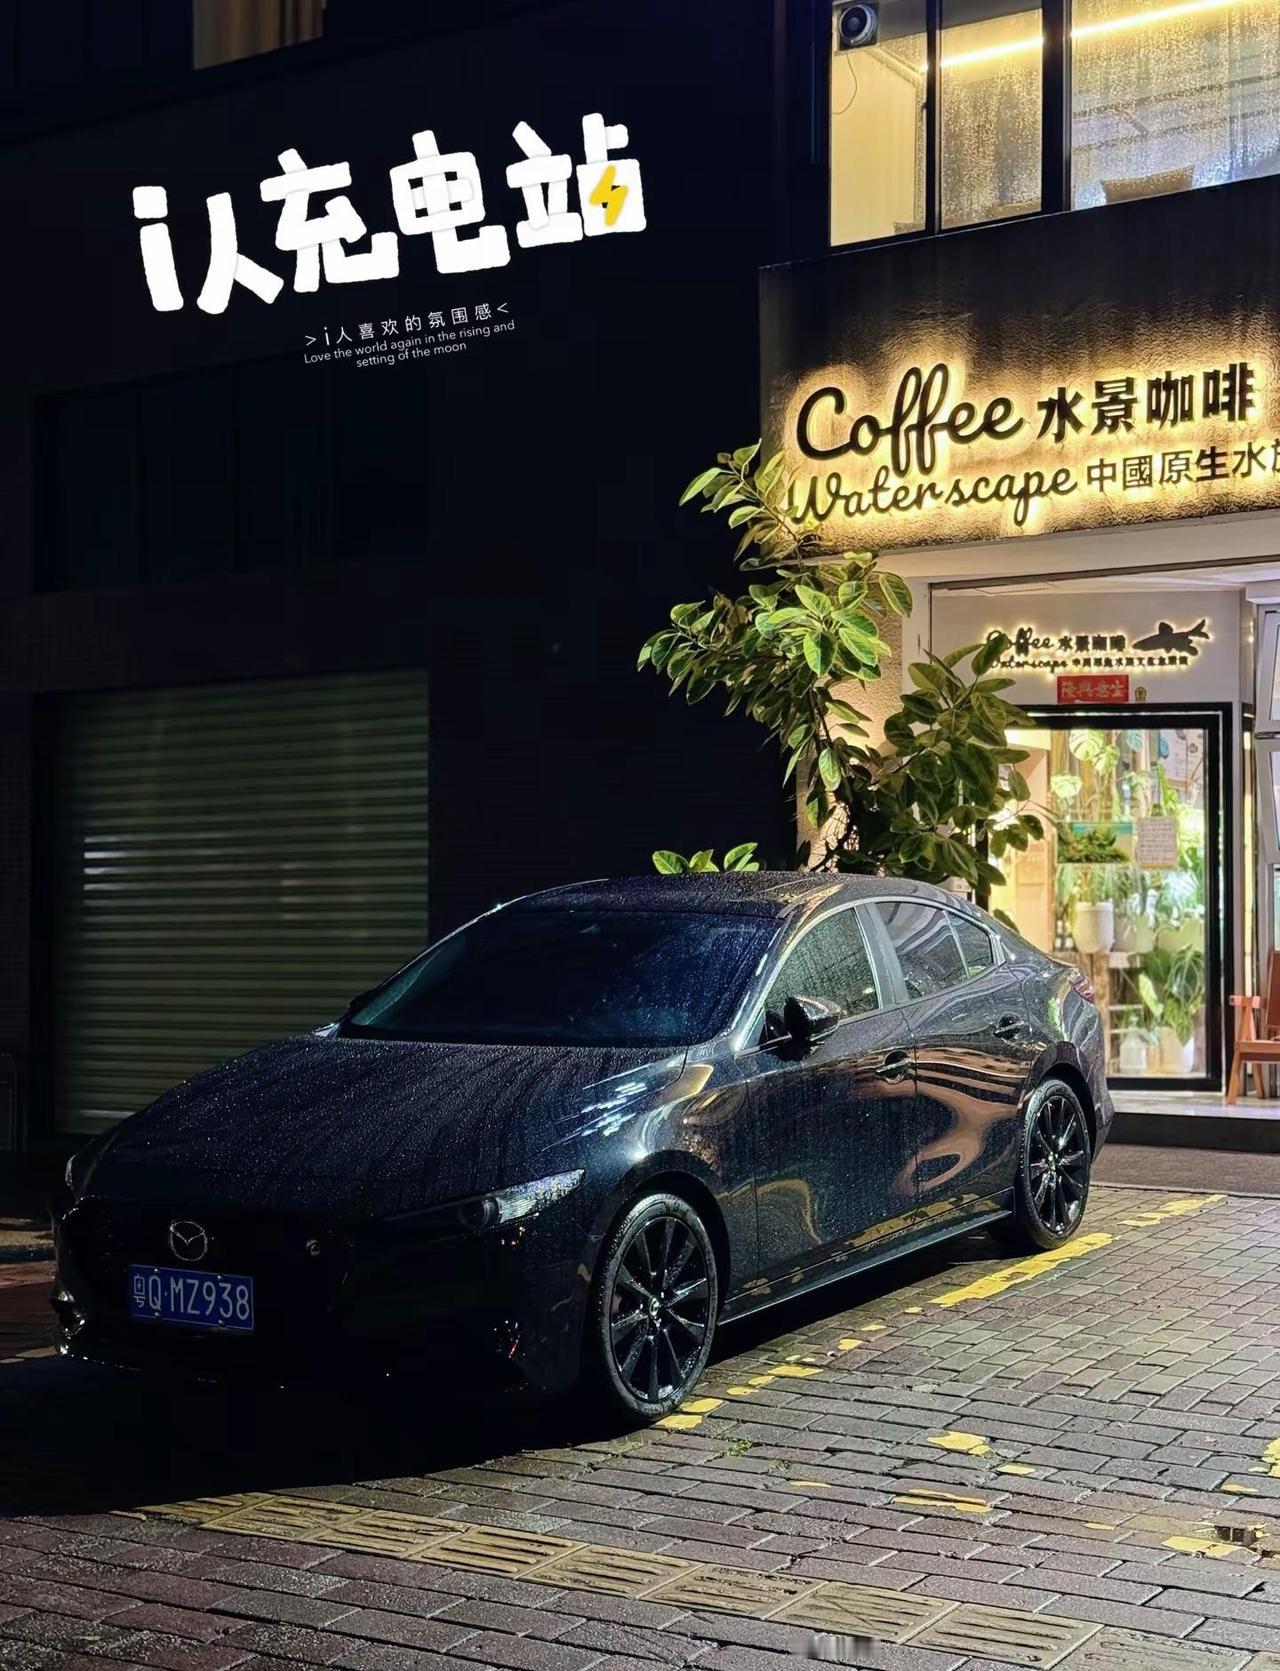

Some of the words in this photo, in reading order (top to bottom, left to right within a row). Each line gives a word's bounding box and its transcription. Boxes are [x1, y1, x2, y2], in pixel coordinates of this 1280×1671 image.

[796, 362, 1024, 477] Coffee
[1036, 361, 1256, 444] 水景咖啡
[787, 464, 1079, 527] Waterscape
[1086, 437, 1280, 494] 中國原生水
